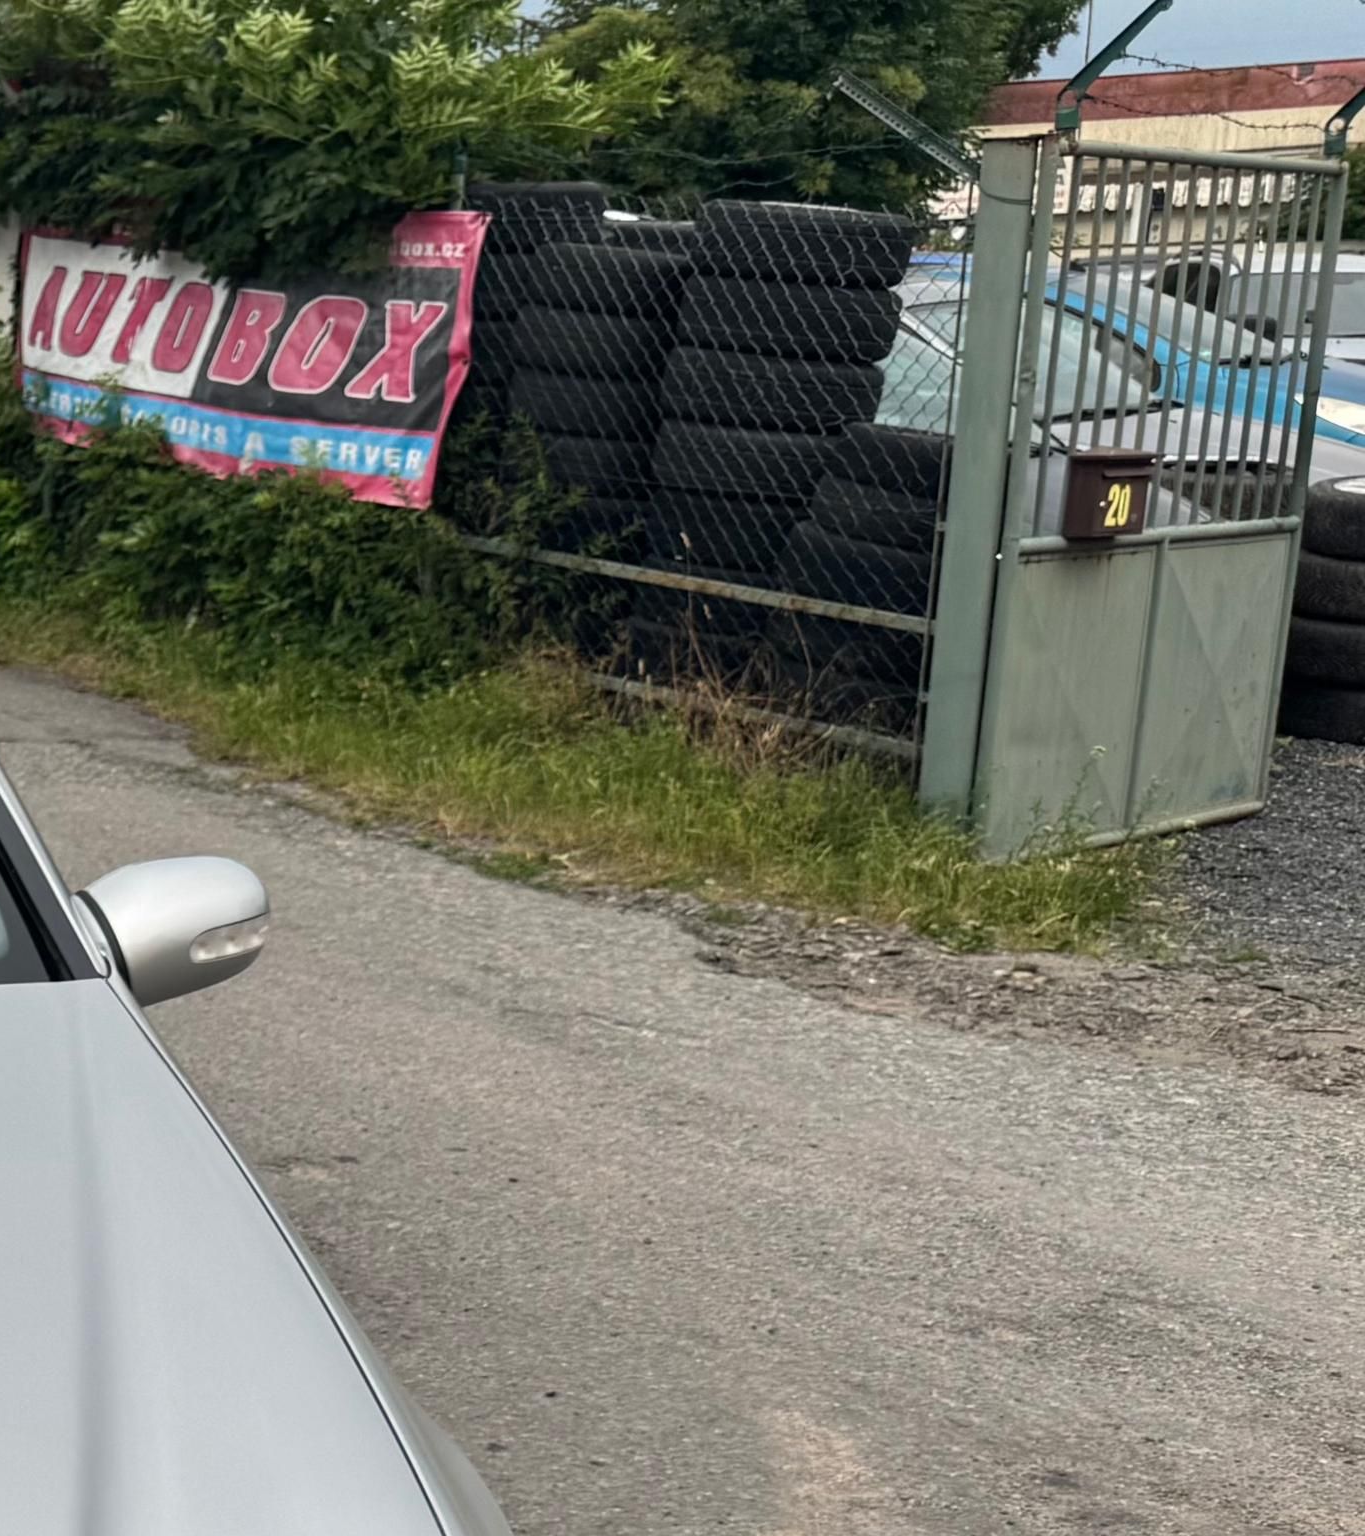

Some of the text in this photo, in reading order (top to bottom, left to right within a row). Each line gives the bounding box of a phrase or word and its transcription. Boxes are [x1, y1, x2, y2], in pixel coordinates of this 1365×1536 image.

[27, 265, 449, 403] AUTOBOX
[289, 435, 425, 472] SERVER
[1103, 483, 1131, 527] 20
